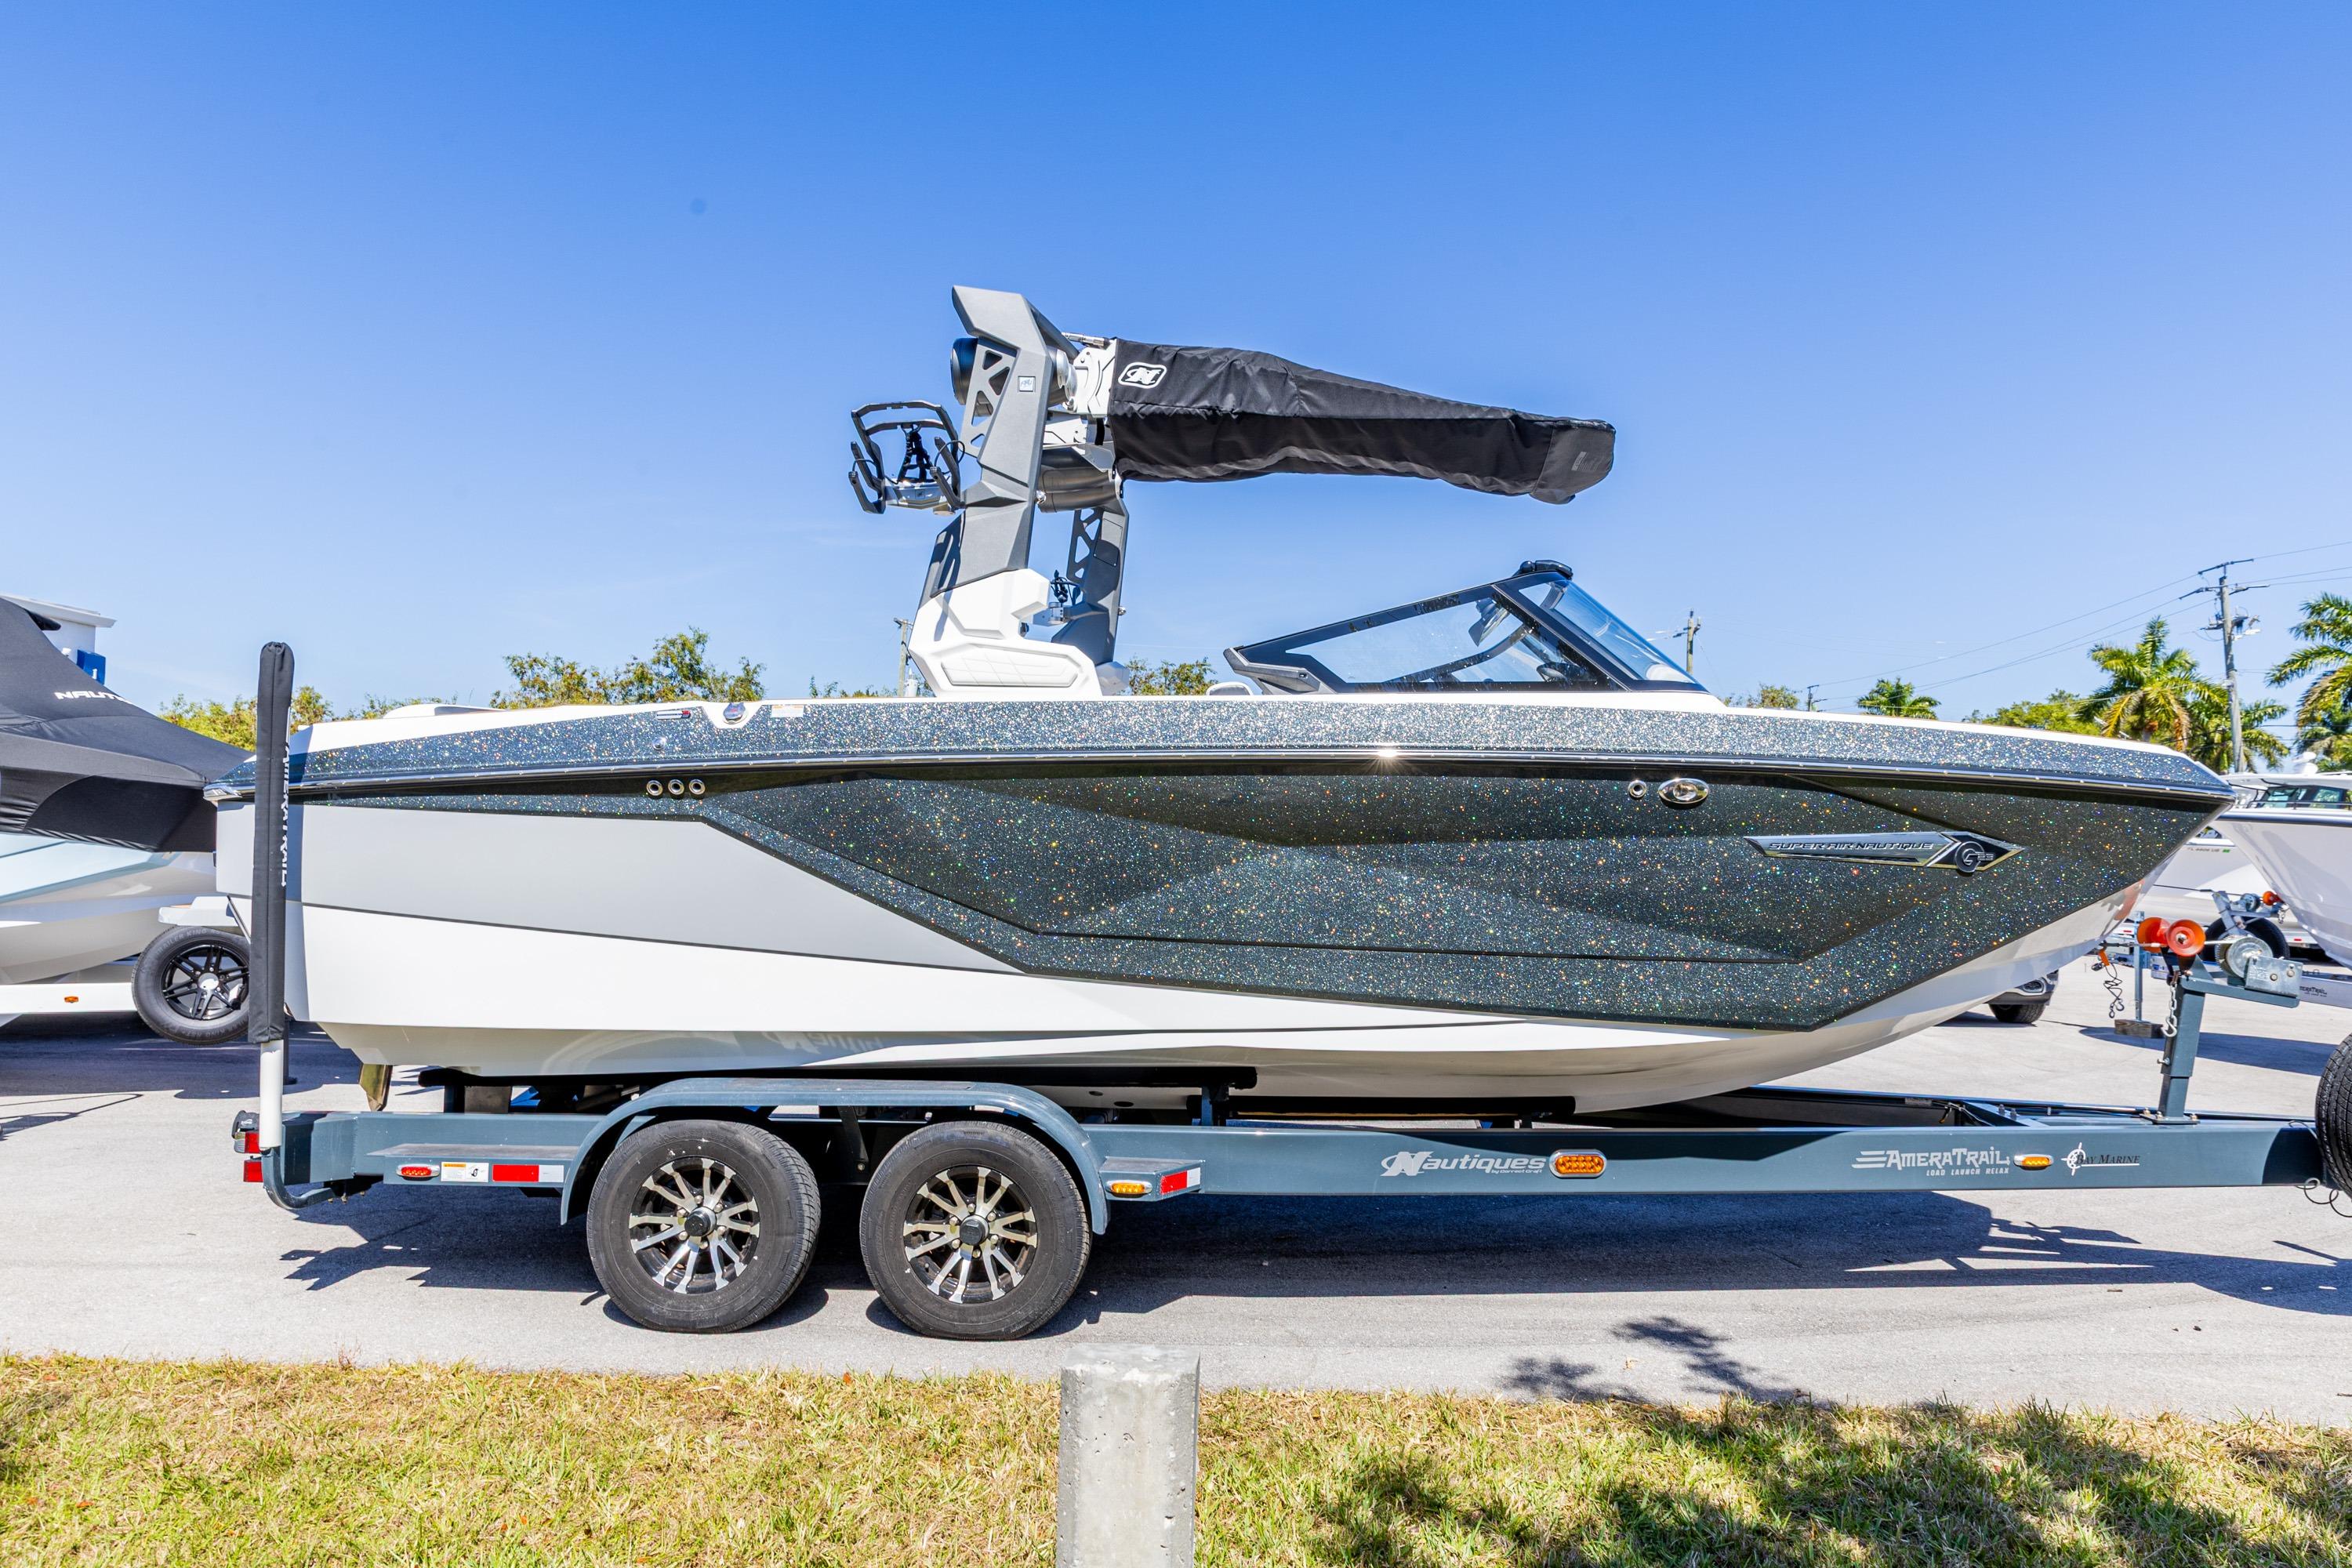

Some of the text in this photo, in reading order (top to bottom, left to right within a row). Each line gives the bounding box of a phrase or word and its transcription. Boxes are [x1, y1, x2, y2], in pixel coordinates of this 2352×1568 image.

[1826, 842, 1854, 851] AIR
[1855, 842, 1934, 851] NAUTIQUE
[2098, 1154, 2141, 1164] MARINE
[1380, 1152, 1547, 1177] Nautiques
